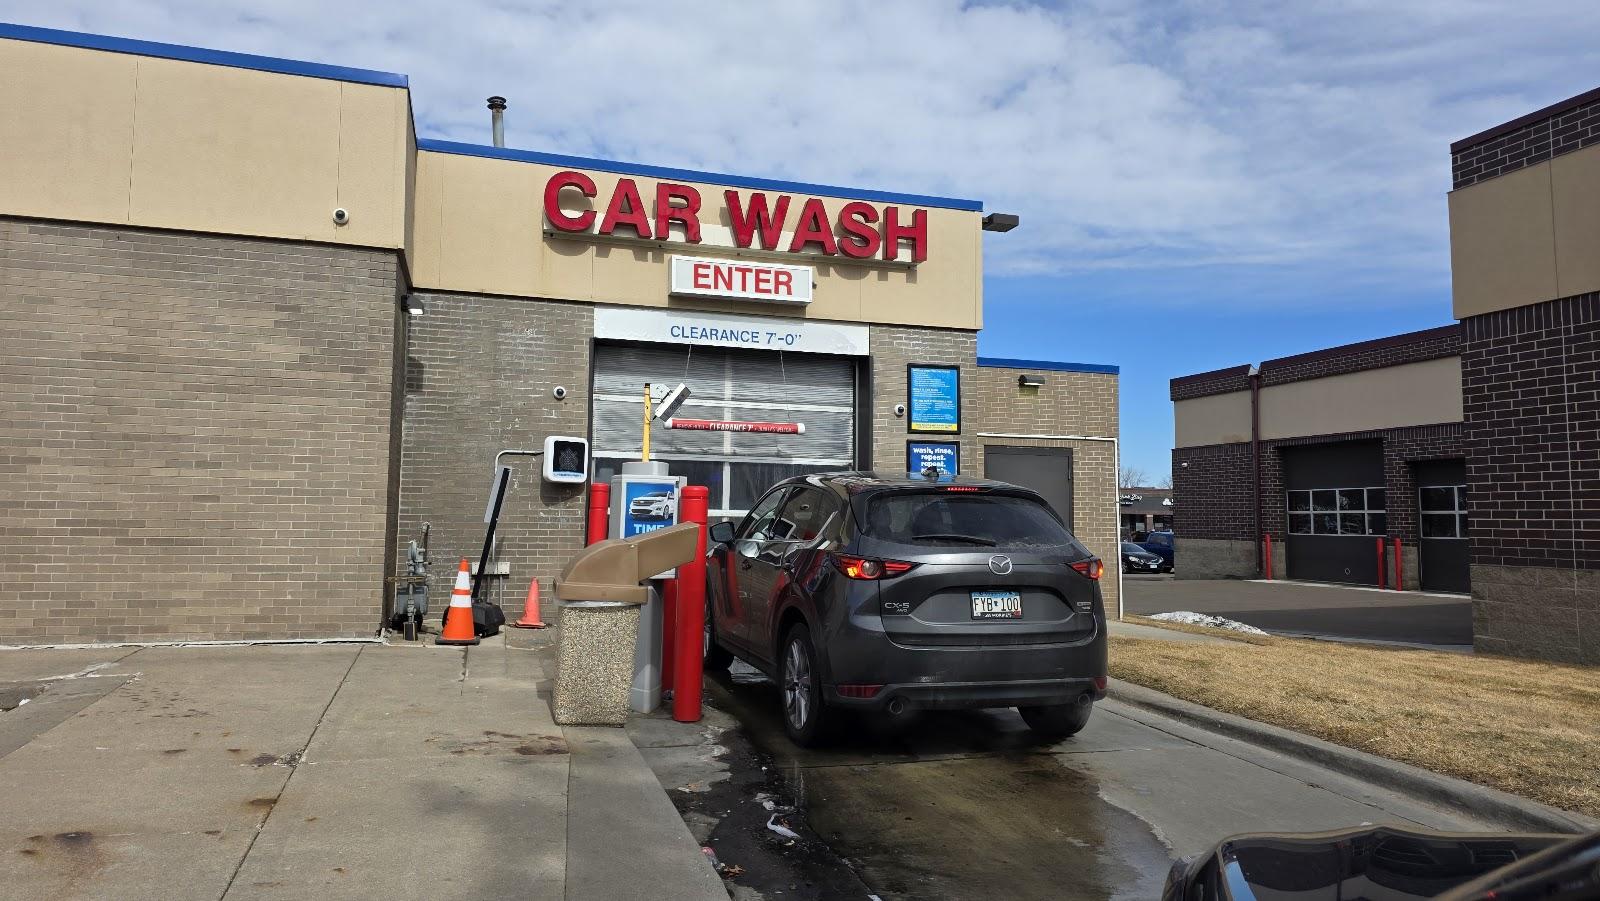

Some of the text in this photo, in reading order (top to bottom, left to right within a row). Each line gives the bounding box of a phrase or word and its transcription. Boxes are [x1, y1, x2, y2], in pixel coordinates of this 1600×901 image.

[543, 171, 928, 263] CAR WASH
[692, 263, 793, 296] ENTER
[670, 325, 760, 344] CLEARANCE
[709, 422, 747, 432] CLEARANCE
[913, 446, 954, 455] wash, rinse,
[974, 597, 1019, 611] FYB 100
